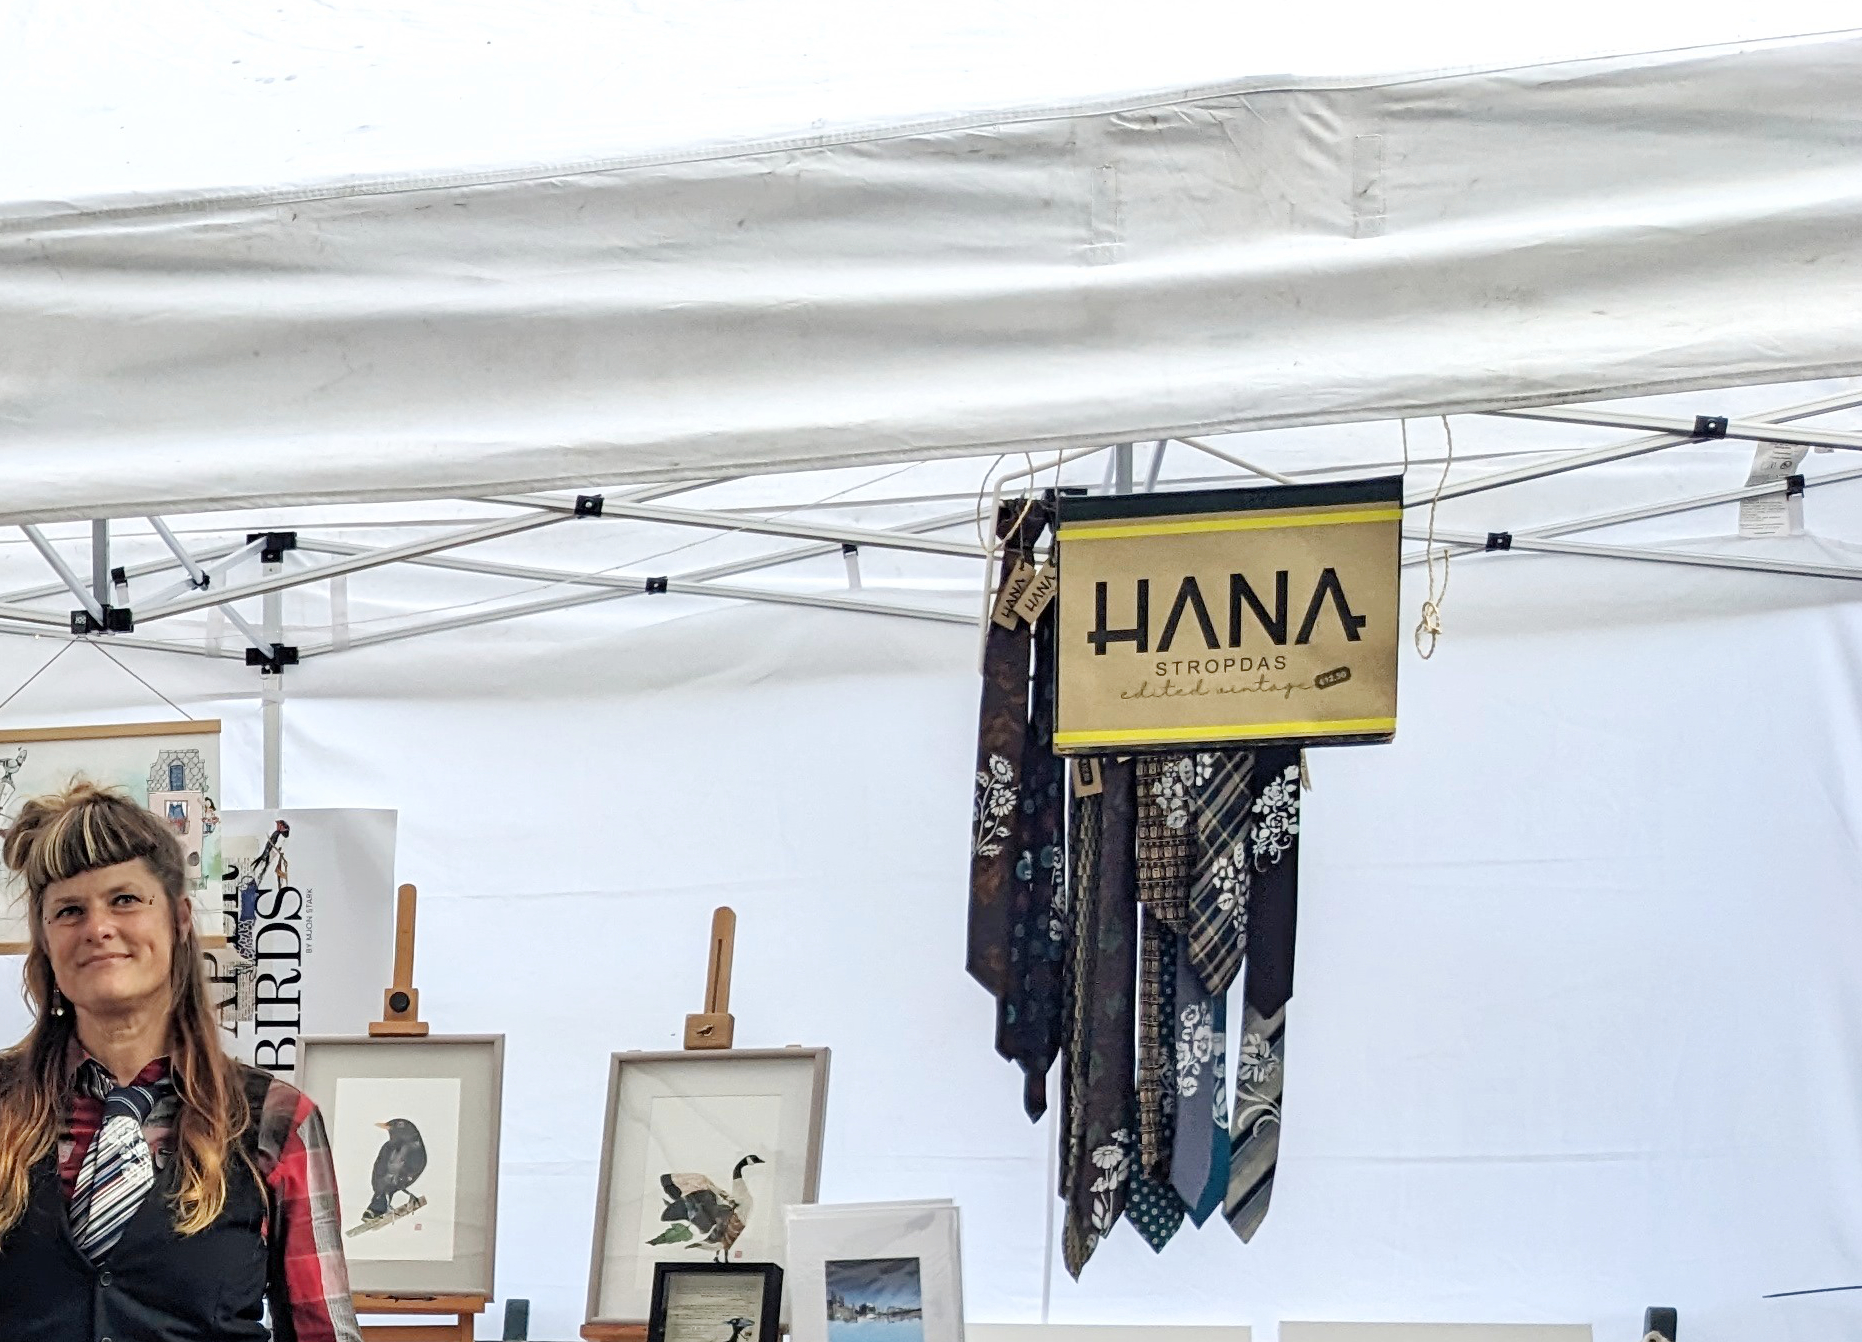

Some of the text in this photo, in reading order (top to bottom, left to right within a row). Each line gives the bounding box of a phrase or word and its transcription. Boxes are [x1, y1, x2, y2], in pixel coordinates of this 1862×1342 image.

[1001, 578, 1025, 618] HANA
[1025, 575, 1056, 612] HANA
[1087, 567, 1366, 655] HANA
[1155, 656, 1287, 677] STROPDAS
[1120, 679, 1209, 700] edited
[1216, 674, 1312, 700] vintage
[305, 943, 313, 954] BY
[255, 886, 303, 1071] BIRDS
